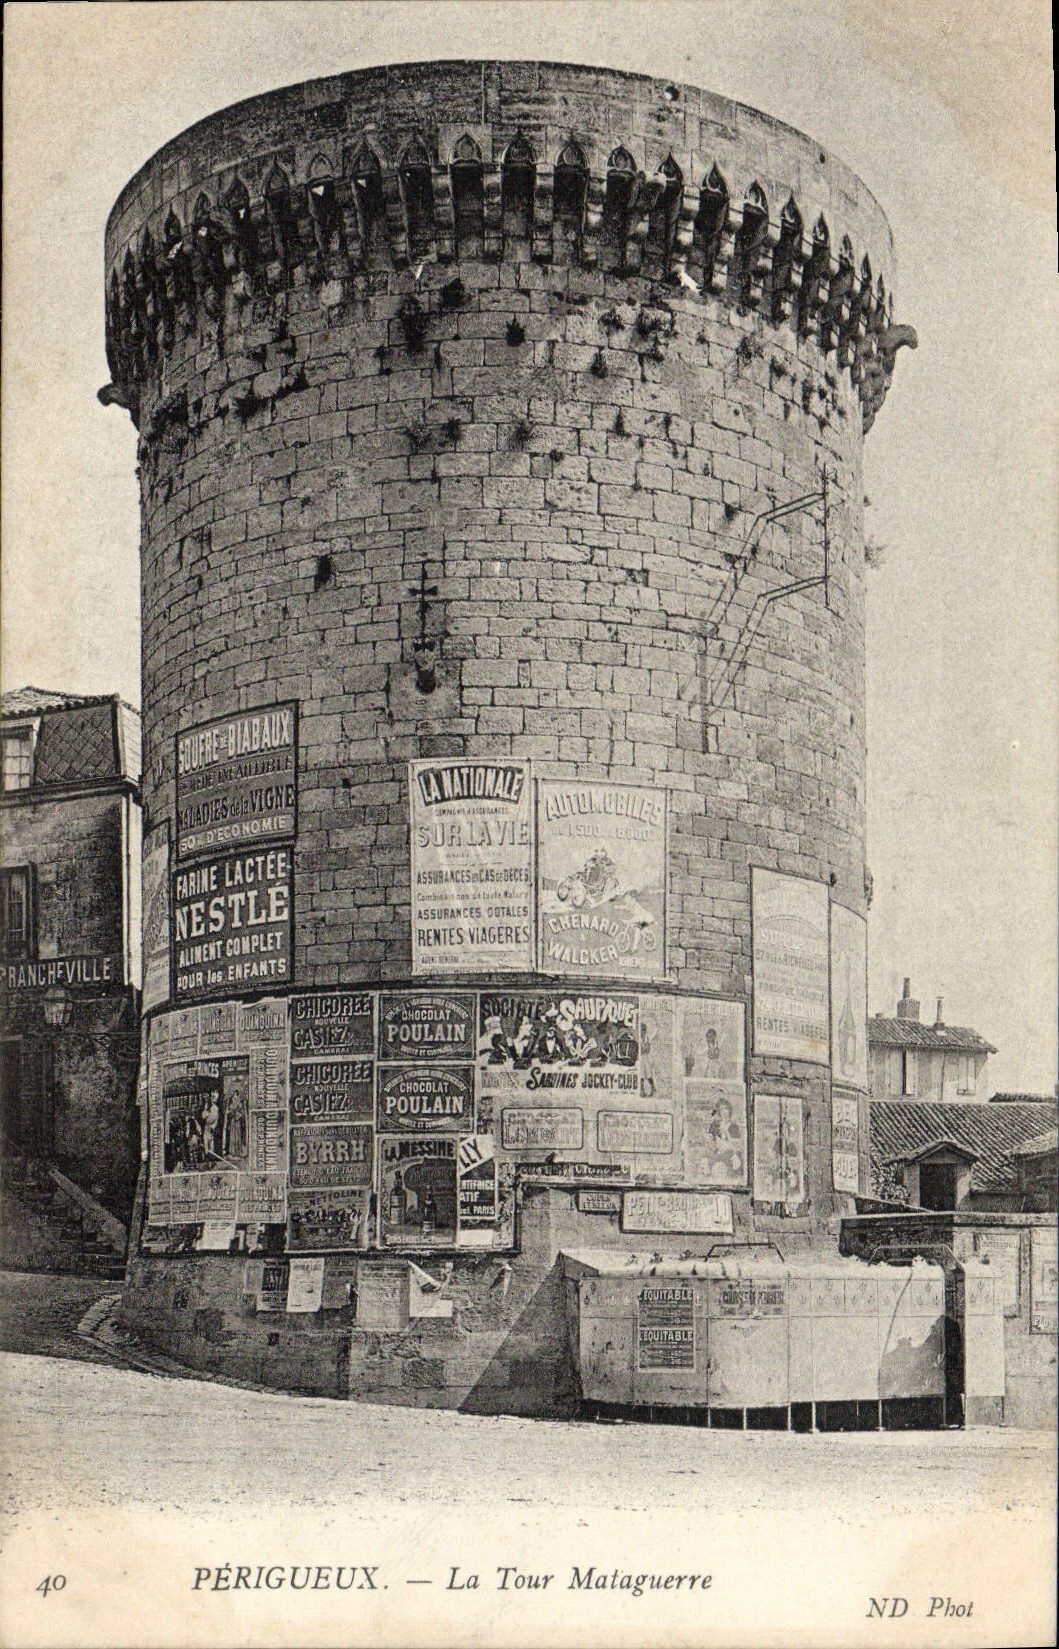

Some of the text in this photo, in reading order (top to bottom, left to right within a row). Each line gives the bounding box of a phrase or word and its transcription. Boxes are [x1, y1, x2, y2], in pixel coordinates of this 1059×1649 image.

[179, 729, 219, 774] SOUFRE
[249, 784, 295, 813] VIGNE
[419, 766, 524, 804] LA NATIONALE
[545, 791, 661, 827] AUTOMOBILES
[418, 820, 530, 848] SUR LA VIE
[176, 865, 218, 900] FARINE
[417, 869, 471, 885] ASSURANCES
[175, 881, 289, 941] NESTLÉ
[417, 905, 529, 920] ASSURANCES DOTALES
[417, 927, 464, 947] RENTES
[548, 914, 619, 938] CHENARD
[179, 932, 283, 969] ALIMENT COMPLET
[547, 938, 618, 965] WALCKER
[177, 958, 287, 992] POUR les ENFANTS
[401, 1009, 452, 1021] CHOCOLAT
[556, 997, 639, 1031] SAUPIQUET
[386, 1023, 466, 1042] POULAIN
[399, 1081, 450, 1093] CHOCOLAT
[526, 1066, 580, 1091] SARDINES
[385, 1095, 464, 1115] POULAIN
[295, 1139, 366, 1165] BYRRH
